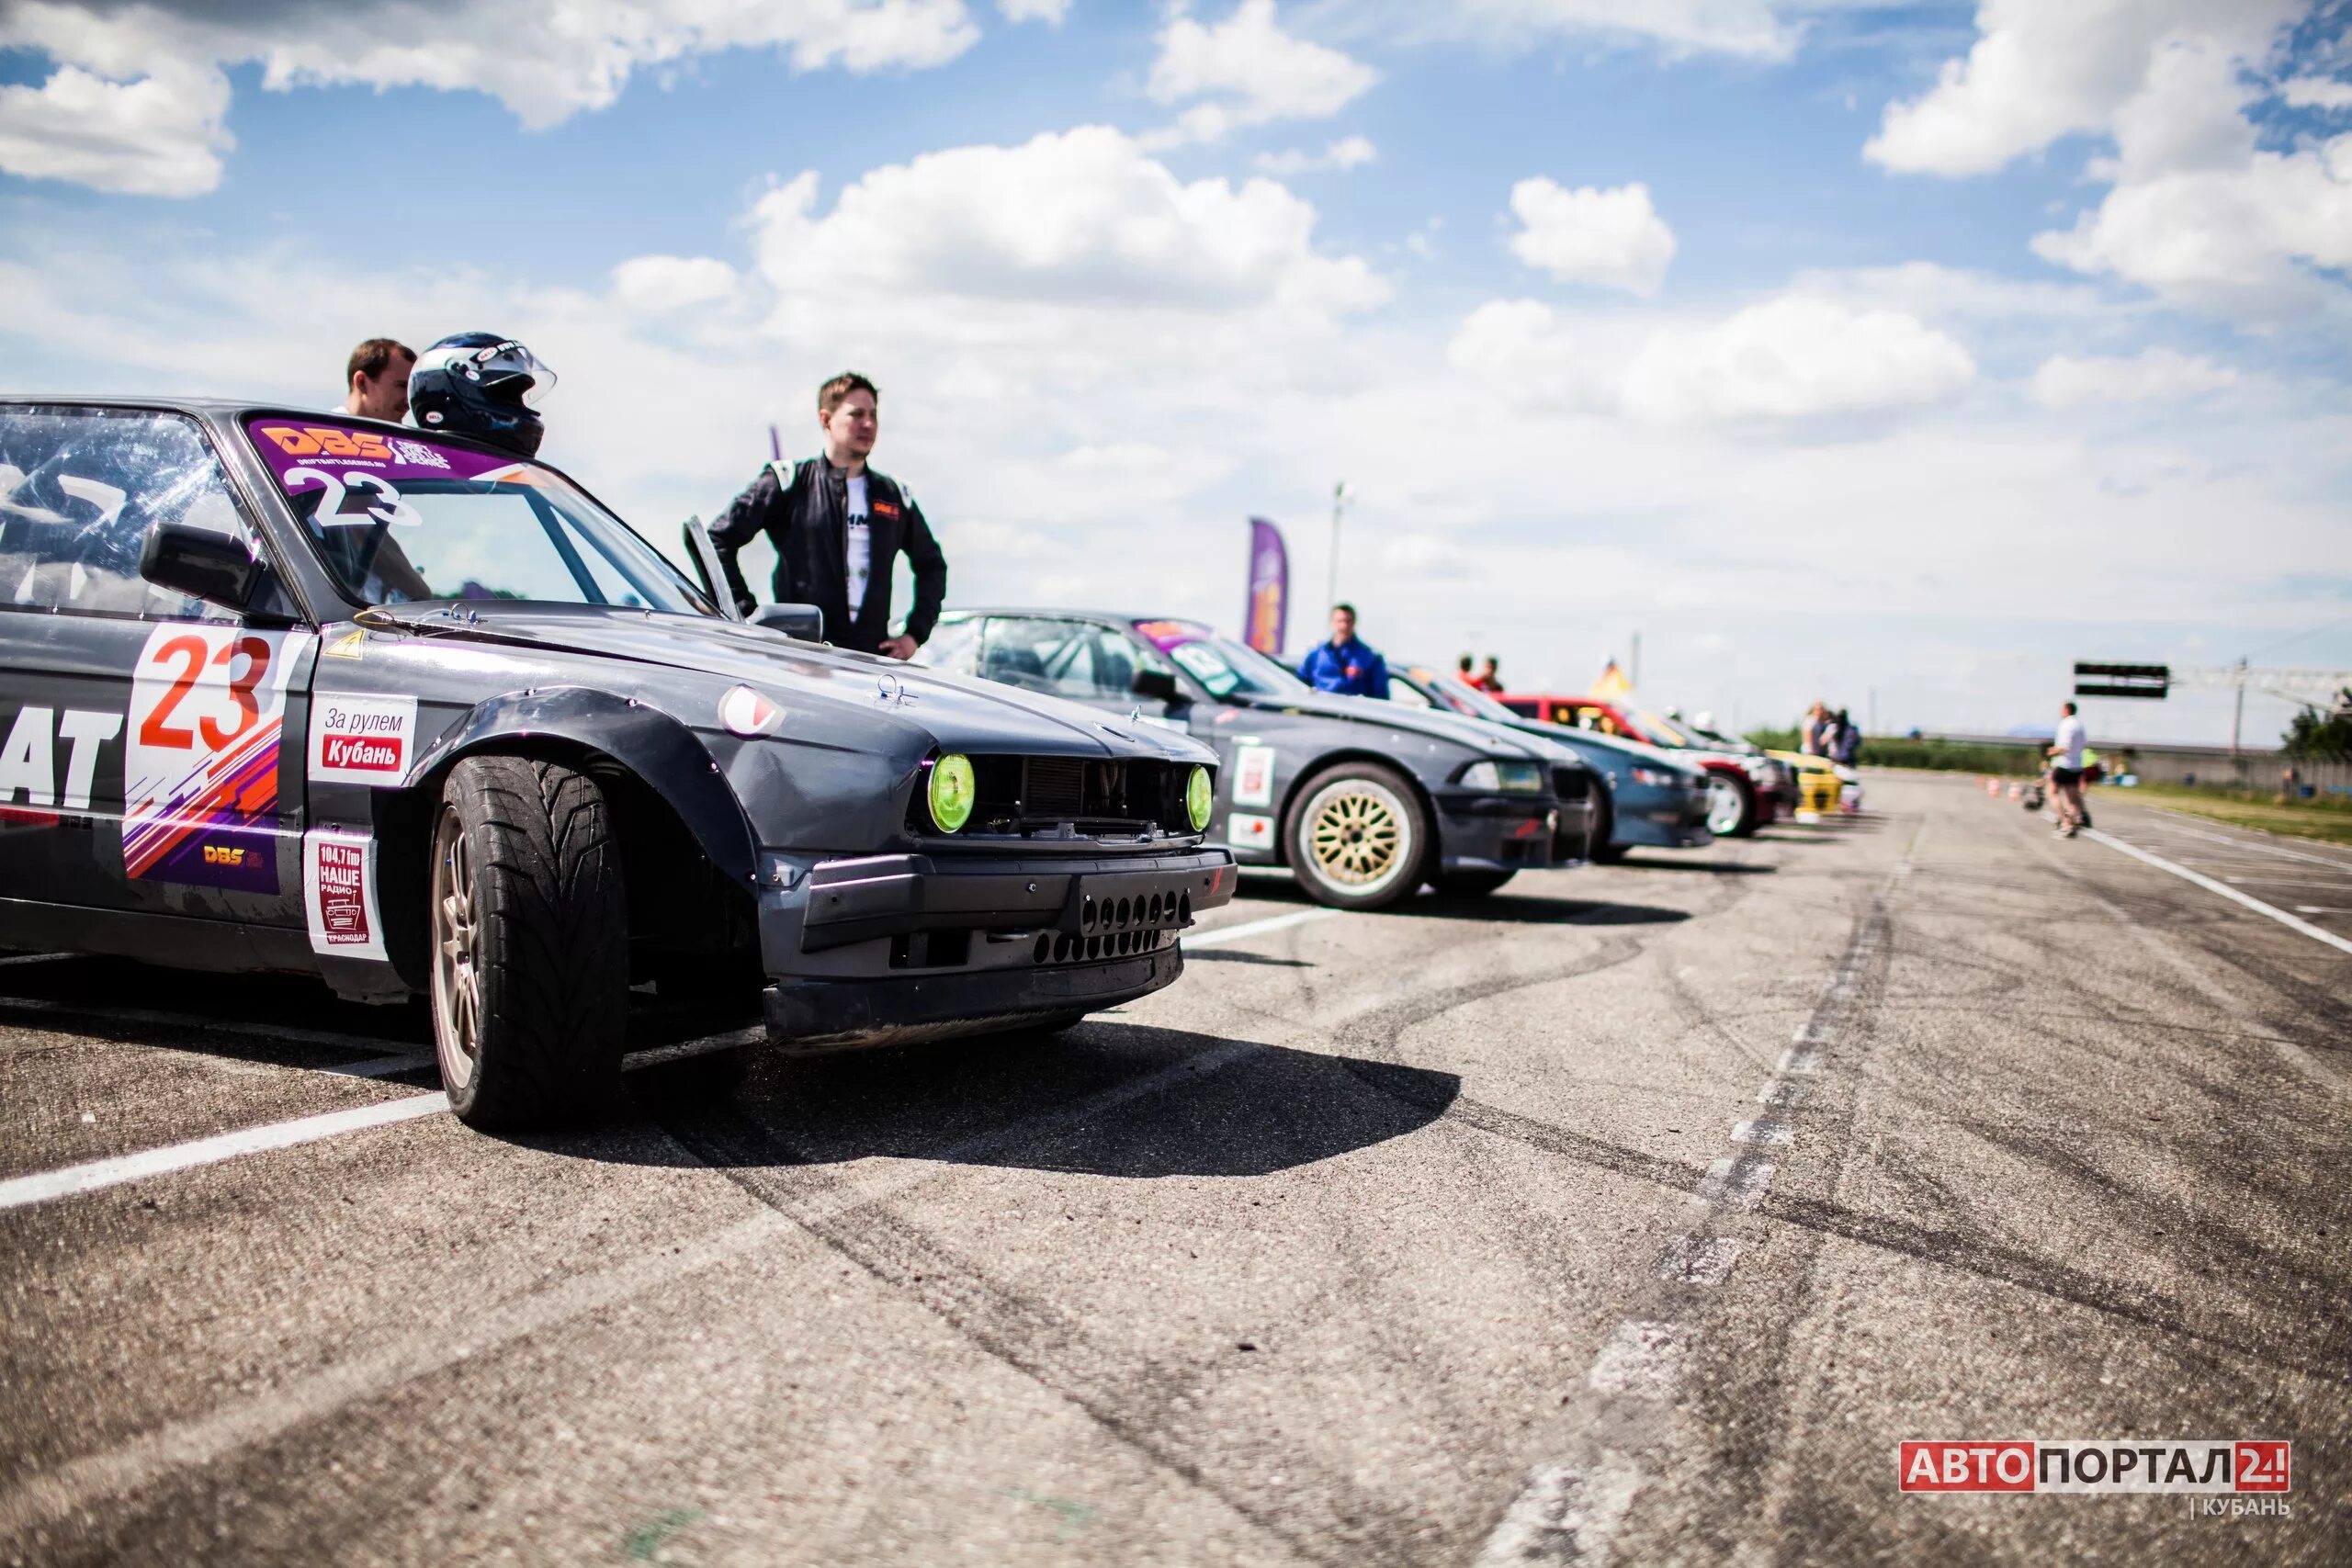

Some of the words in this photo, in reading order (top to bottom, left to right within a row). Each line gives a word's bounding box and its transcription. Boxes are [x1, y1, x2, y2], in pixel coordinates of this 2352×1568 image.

[284, 467, 423, 527] 23
[140, 634, 270, 753] 23
[325, 707, 346, 728] За
[349, 713, 403, 734] рулем
[328, 739, 396, 767] Кубань
[204, 845, 245, 866] DBS
[321, 846, 346, 864] 104,7
[321, 866, 360, 886] НАШЕ
[321, 885, 353, 896] РАДИО
[328, 933, 368, 942] КРАСНОДАР
